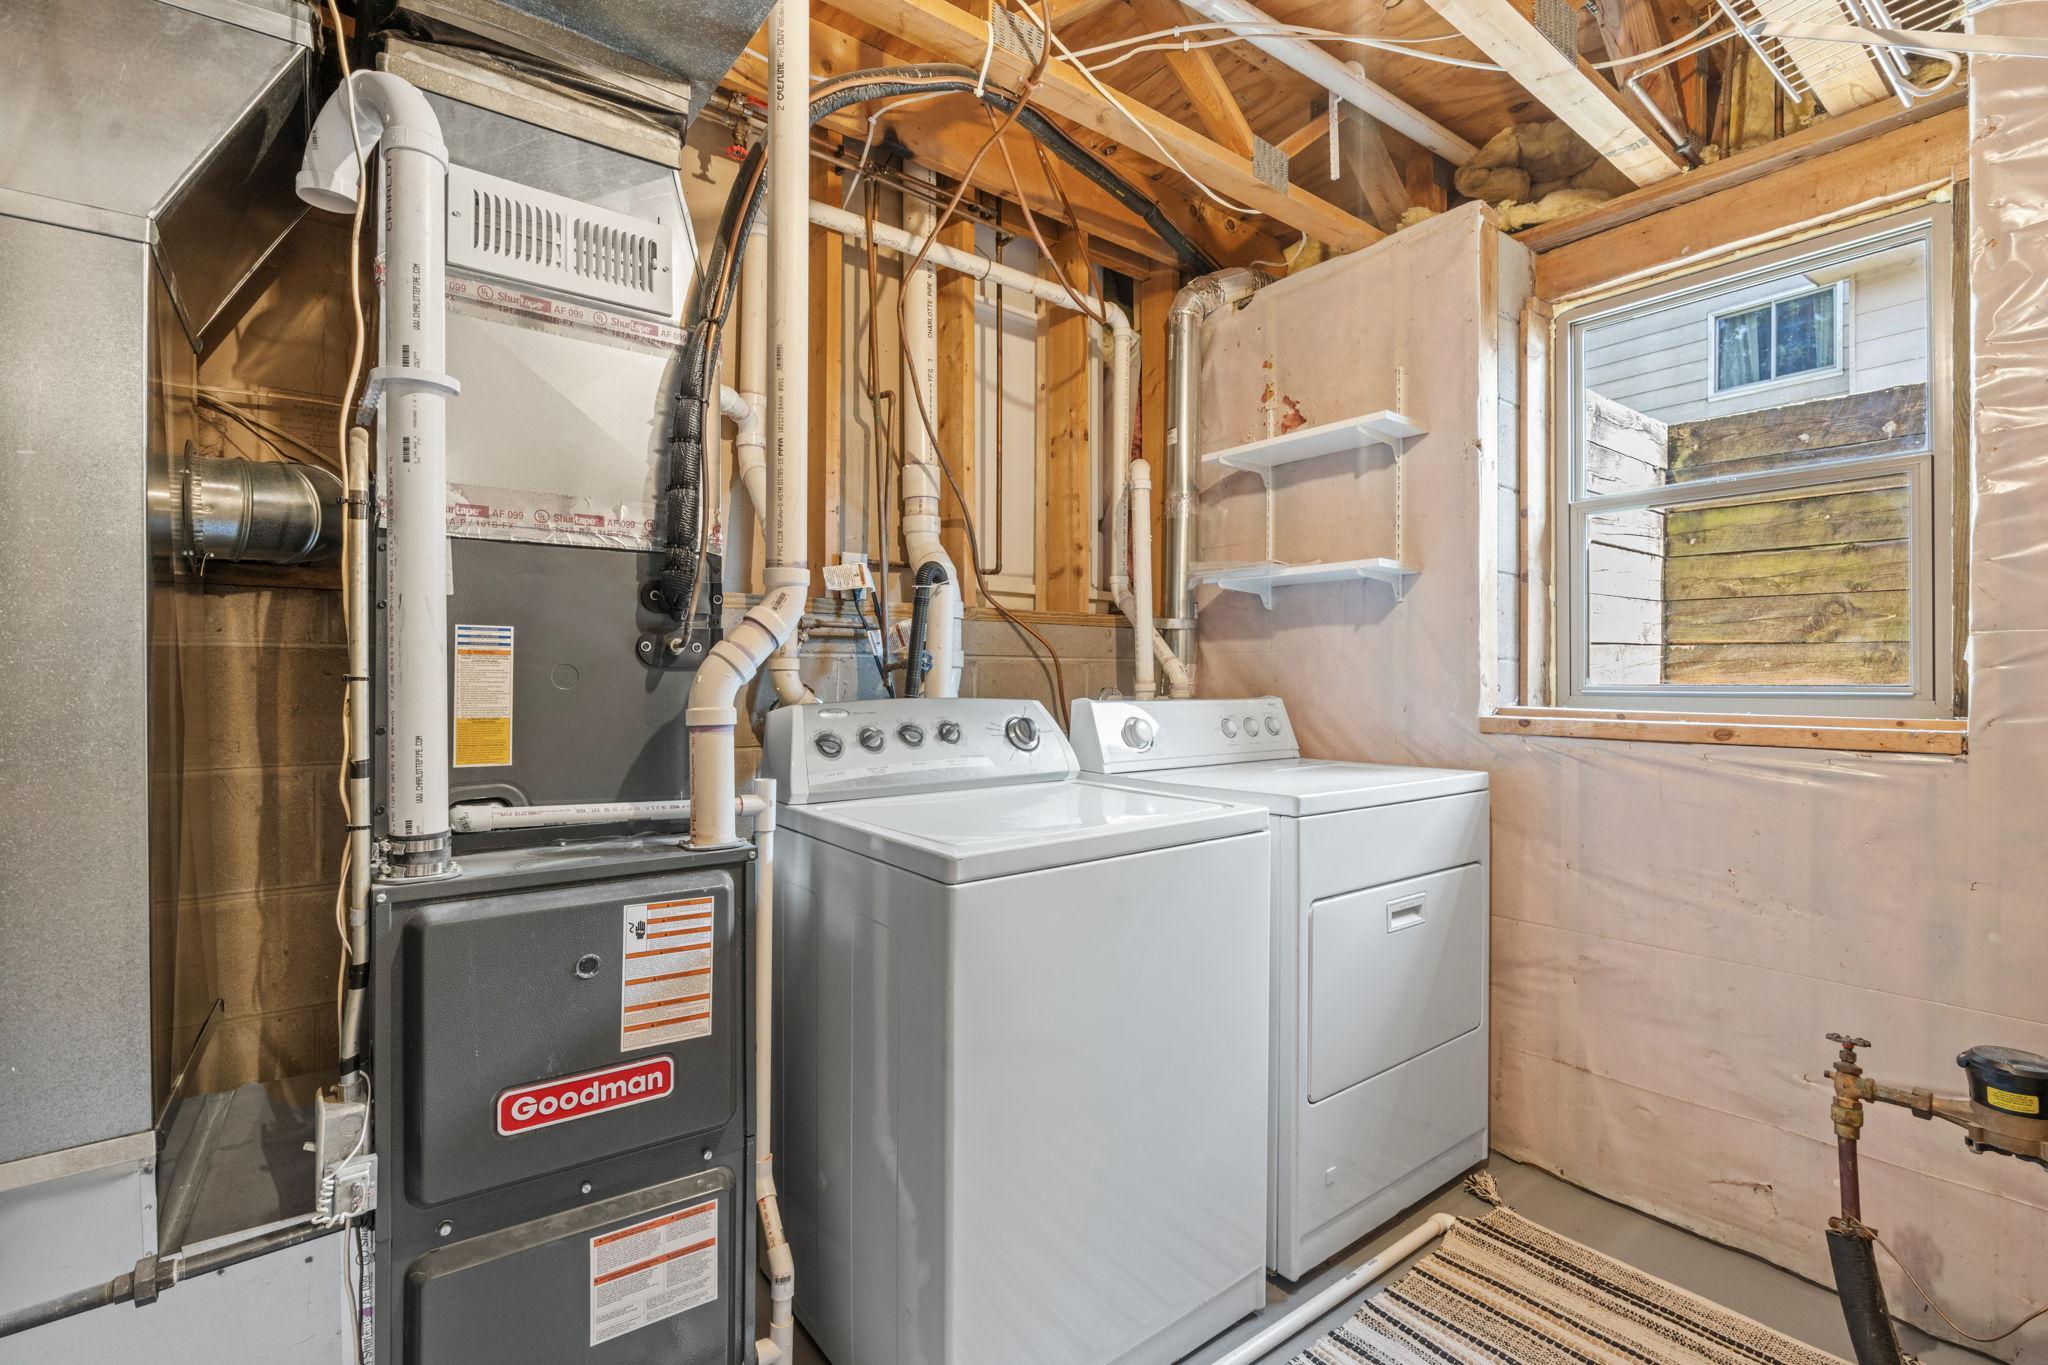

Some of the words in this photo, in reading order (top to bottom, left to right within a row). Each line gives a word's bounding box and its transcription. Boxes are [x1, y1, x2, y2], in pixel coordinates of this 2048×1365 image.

[449, 282, 466, 293] 099
[498, 292, 545, 310] Shurtape
[554, 305, 567, 314] AF
[568, 308, 584, 319] 099
[661, 330, 672, 338] AF
[492, 509, 505, 518] AF
[508, 510, 524, 520] 099
[553, 513, 600, 526] Shurtape
[415, 735, 423, 804] WWW.CHARLOTTEPIPE.COM
[512, 1071, 663, 1120] Goodman
